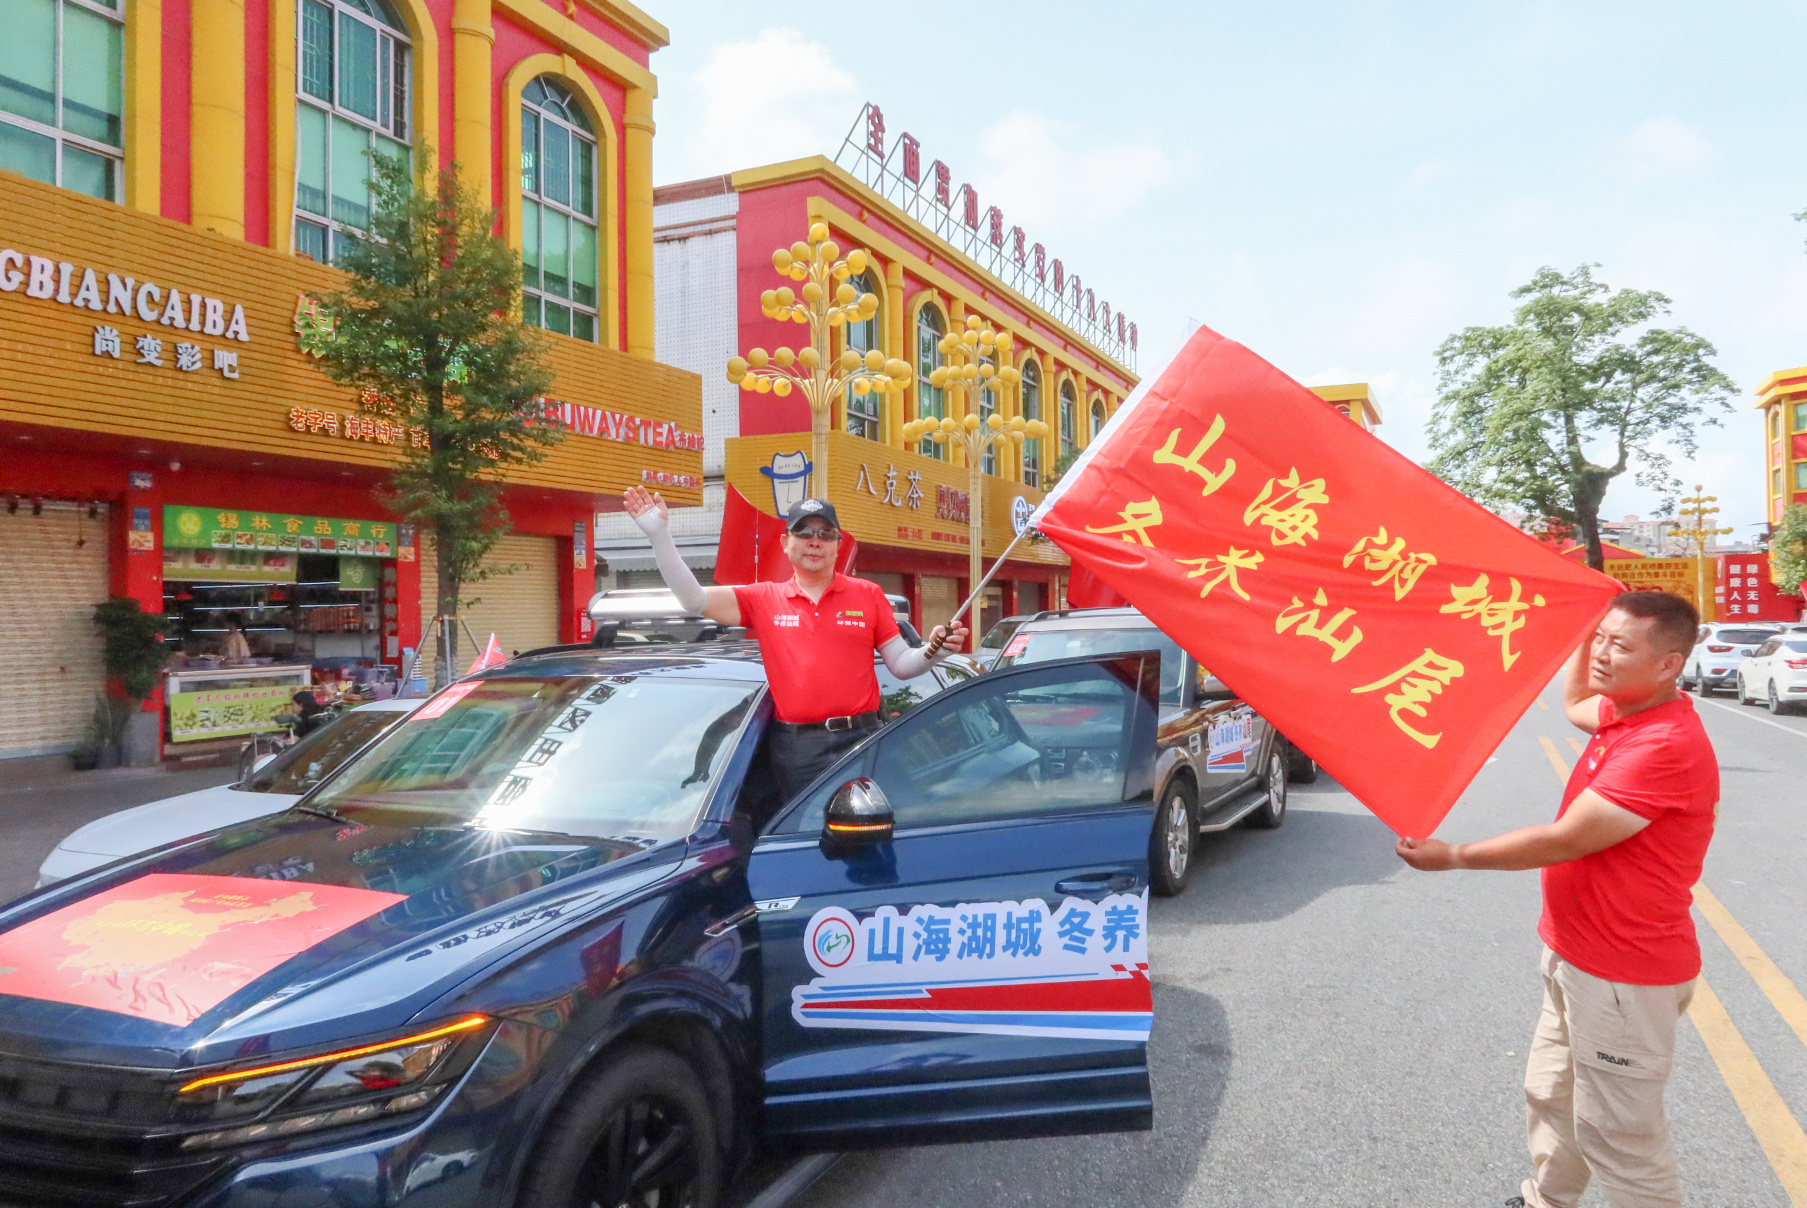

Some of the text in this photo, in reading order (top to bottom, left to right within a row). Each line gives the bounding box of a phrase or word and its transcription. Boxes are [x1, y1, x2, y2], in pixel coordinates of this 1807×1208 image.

[93, 325, 240, 379] 尚变彩吧
[290, 406, 339, 436] 老字号
[639, 419, 678, 450] TEA
[856, 463, 925, 510] 八克茶
[217, 512, 388, 539] 锡林食品商行
[1153, 413, 1546, 672] 山海湖城
[1007, 642, 1025, 654] 02
[866, 904, 1141, 965] 山海湖城 冬养
